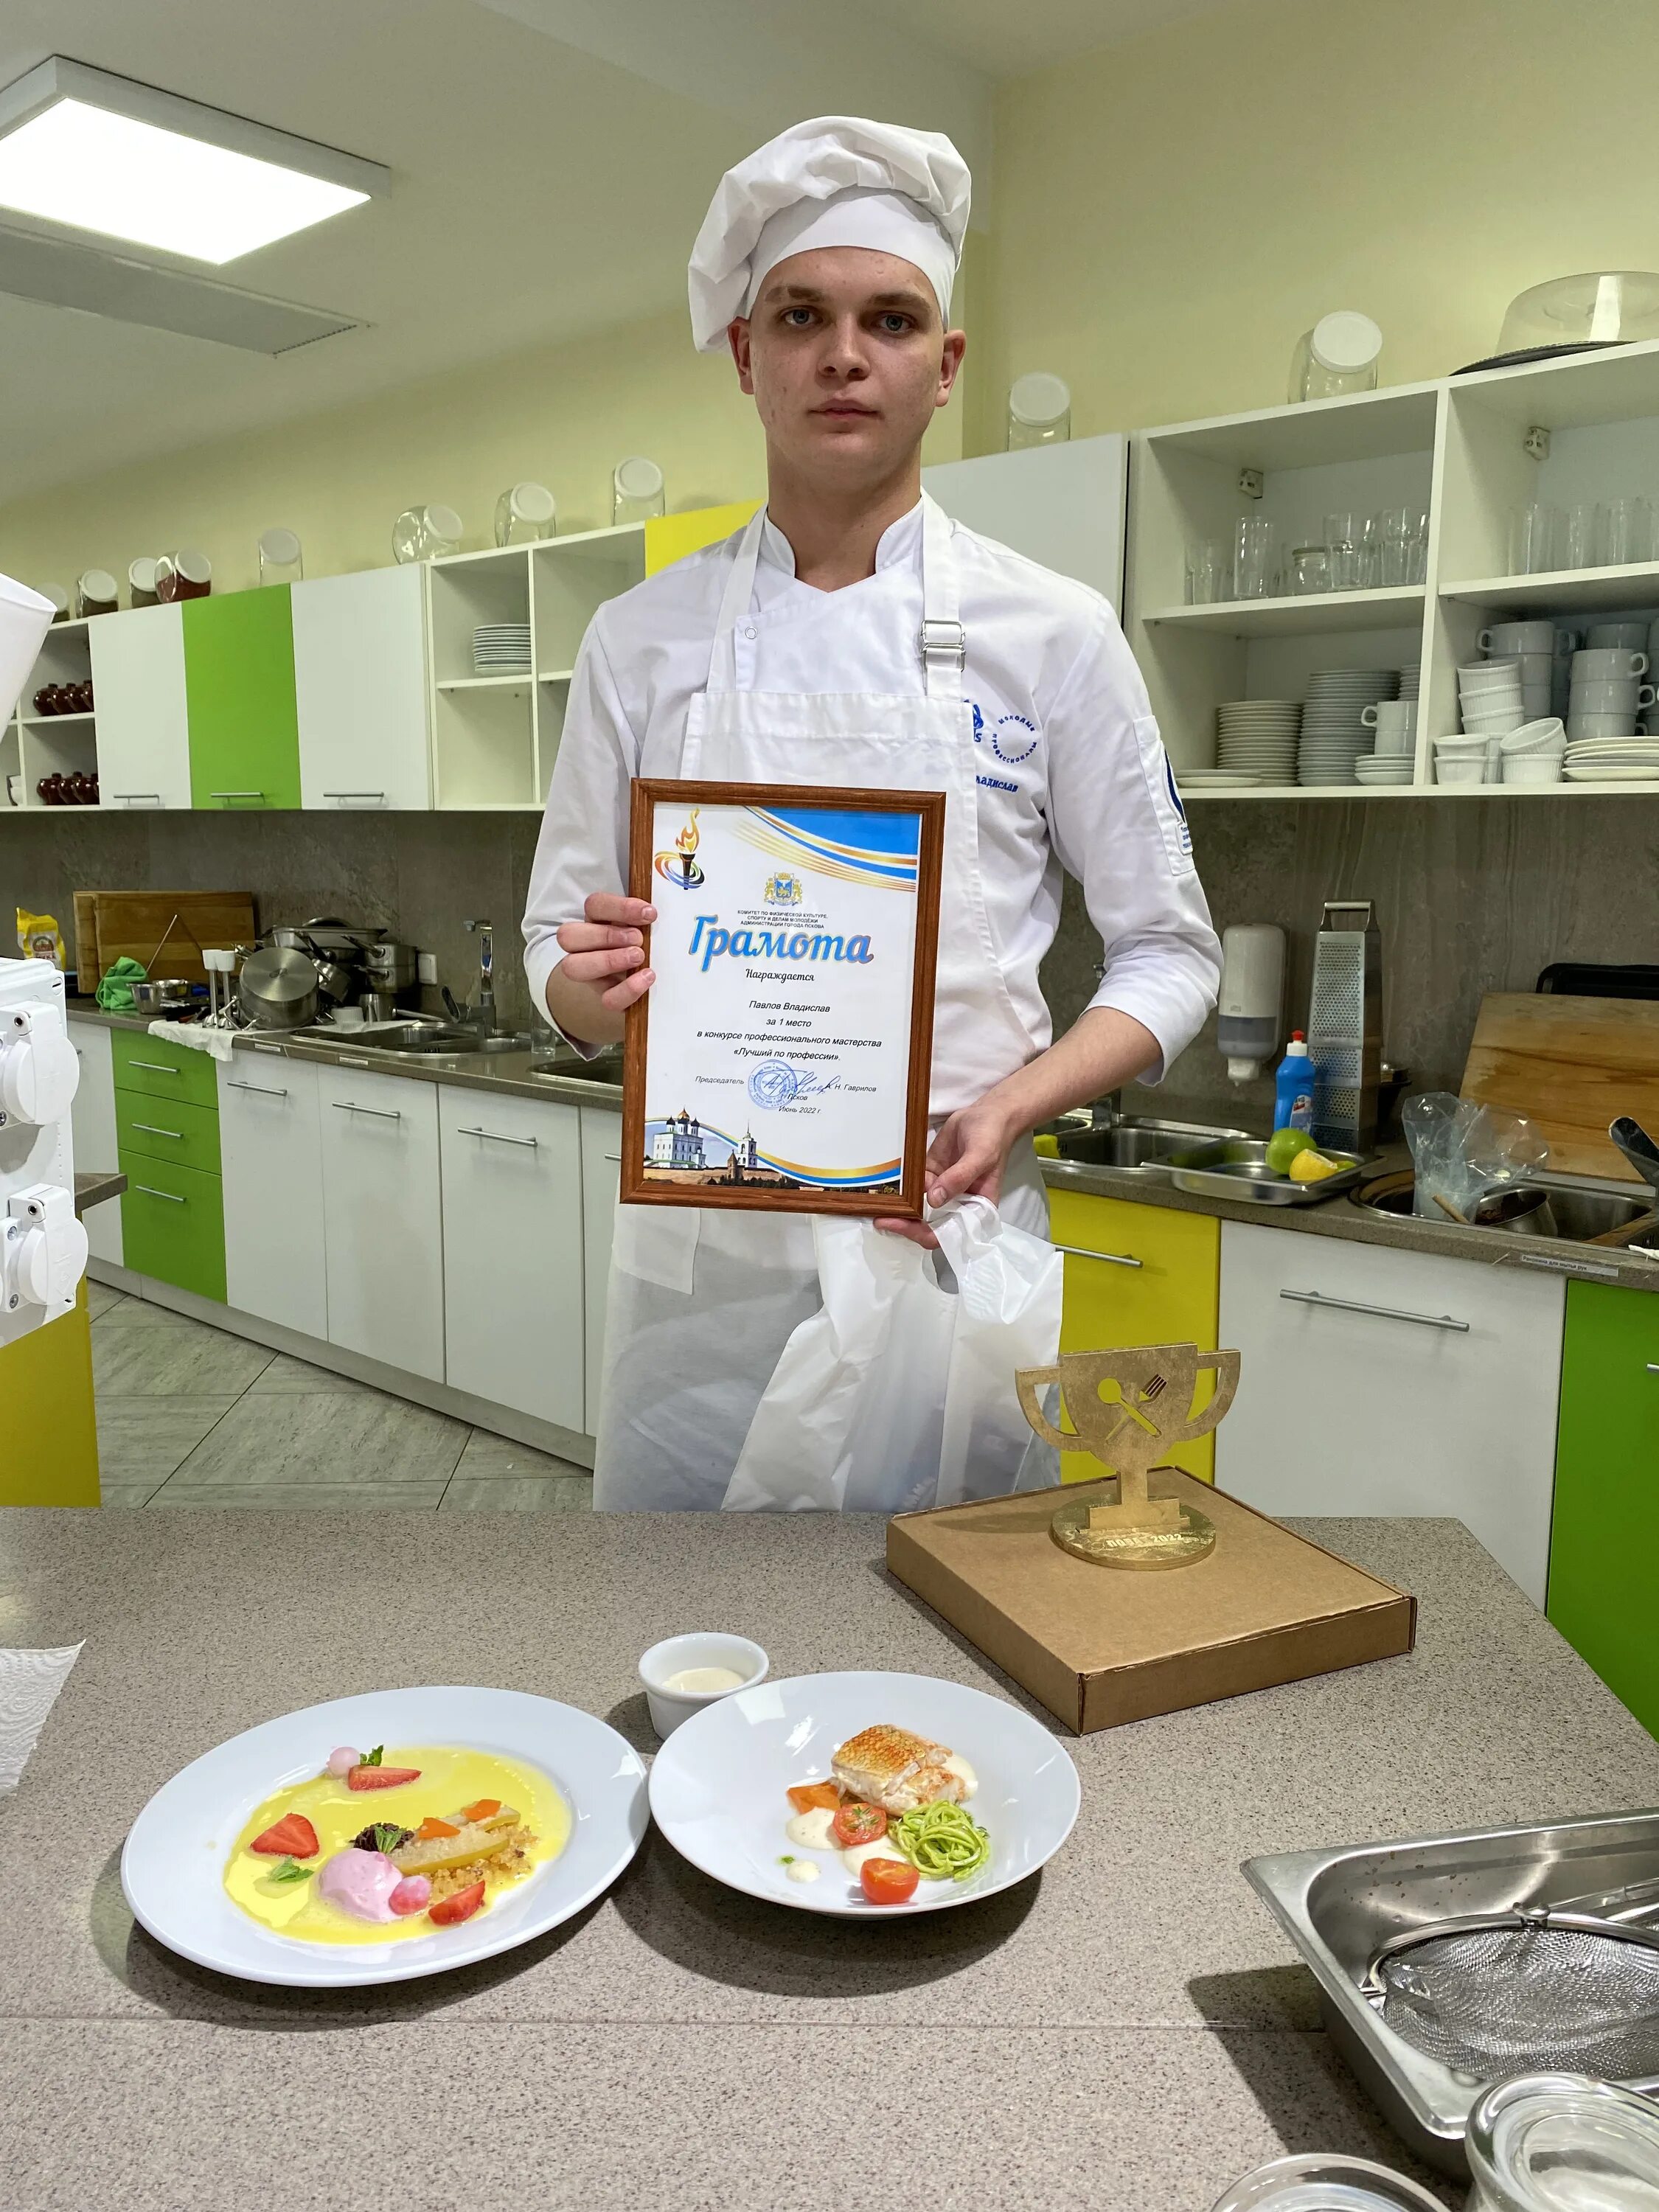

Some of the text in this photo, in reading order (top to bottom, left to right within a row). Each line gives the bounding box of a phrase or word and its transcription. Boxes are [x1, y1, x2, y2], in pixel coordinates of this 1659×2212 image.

[689, 914, 874, 973] Грамота
[745, 968, 815, 983] Награждается
[749, 1001, 831, 1012] Павлов Владислав
[785, 1020, 812, 1028] место
[704, 1032, 742, 1041] конкурсе
[744, 1033, 831, 1045] профессионального
[832, 1038, 882, 1048] мастерства
[734, 1048, 772, 1059] «Лучший
[695, 1076, 745, 1085] Председатель
[844, 1084, 877, 1092] Гаврилов
[1151, 1534, 1184, 1543] 2022
